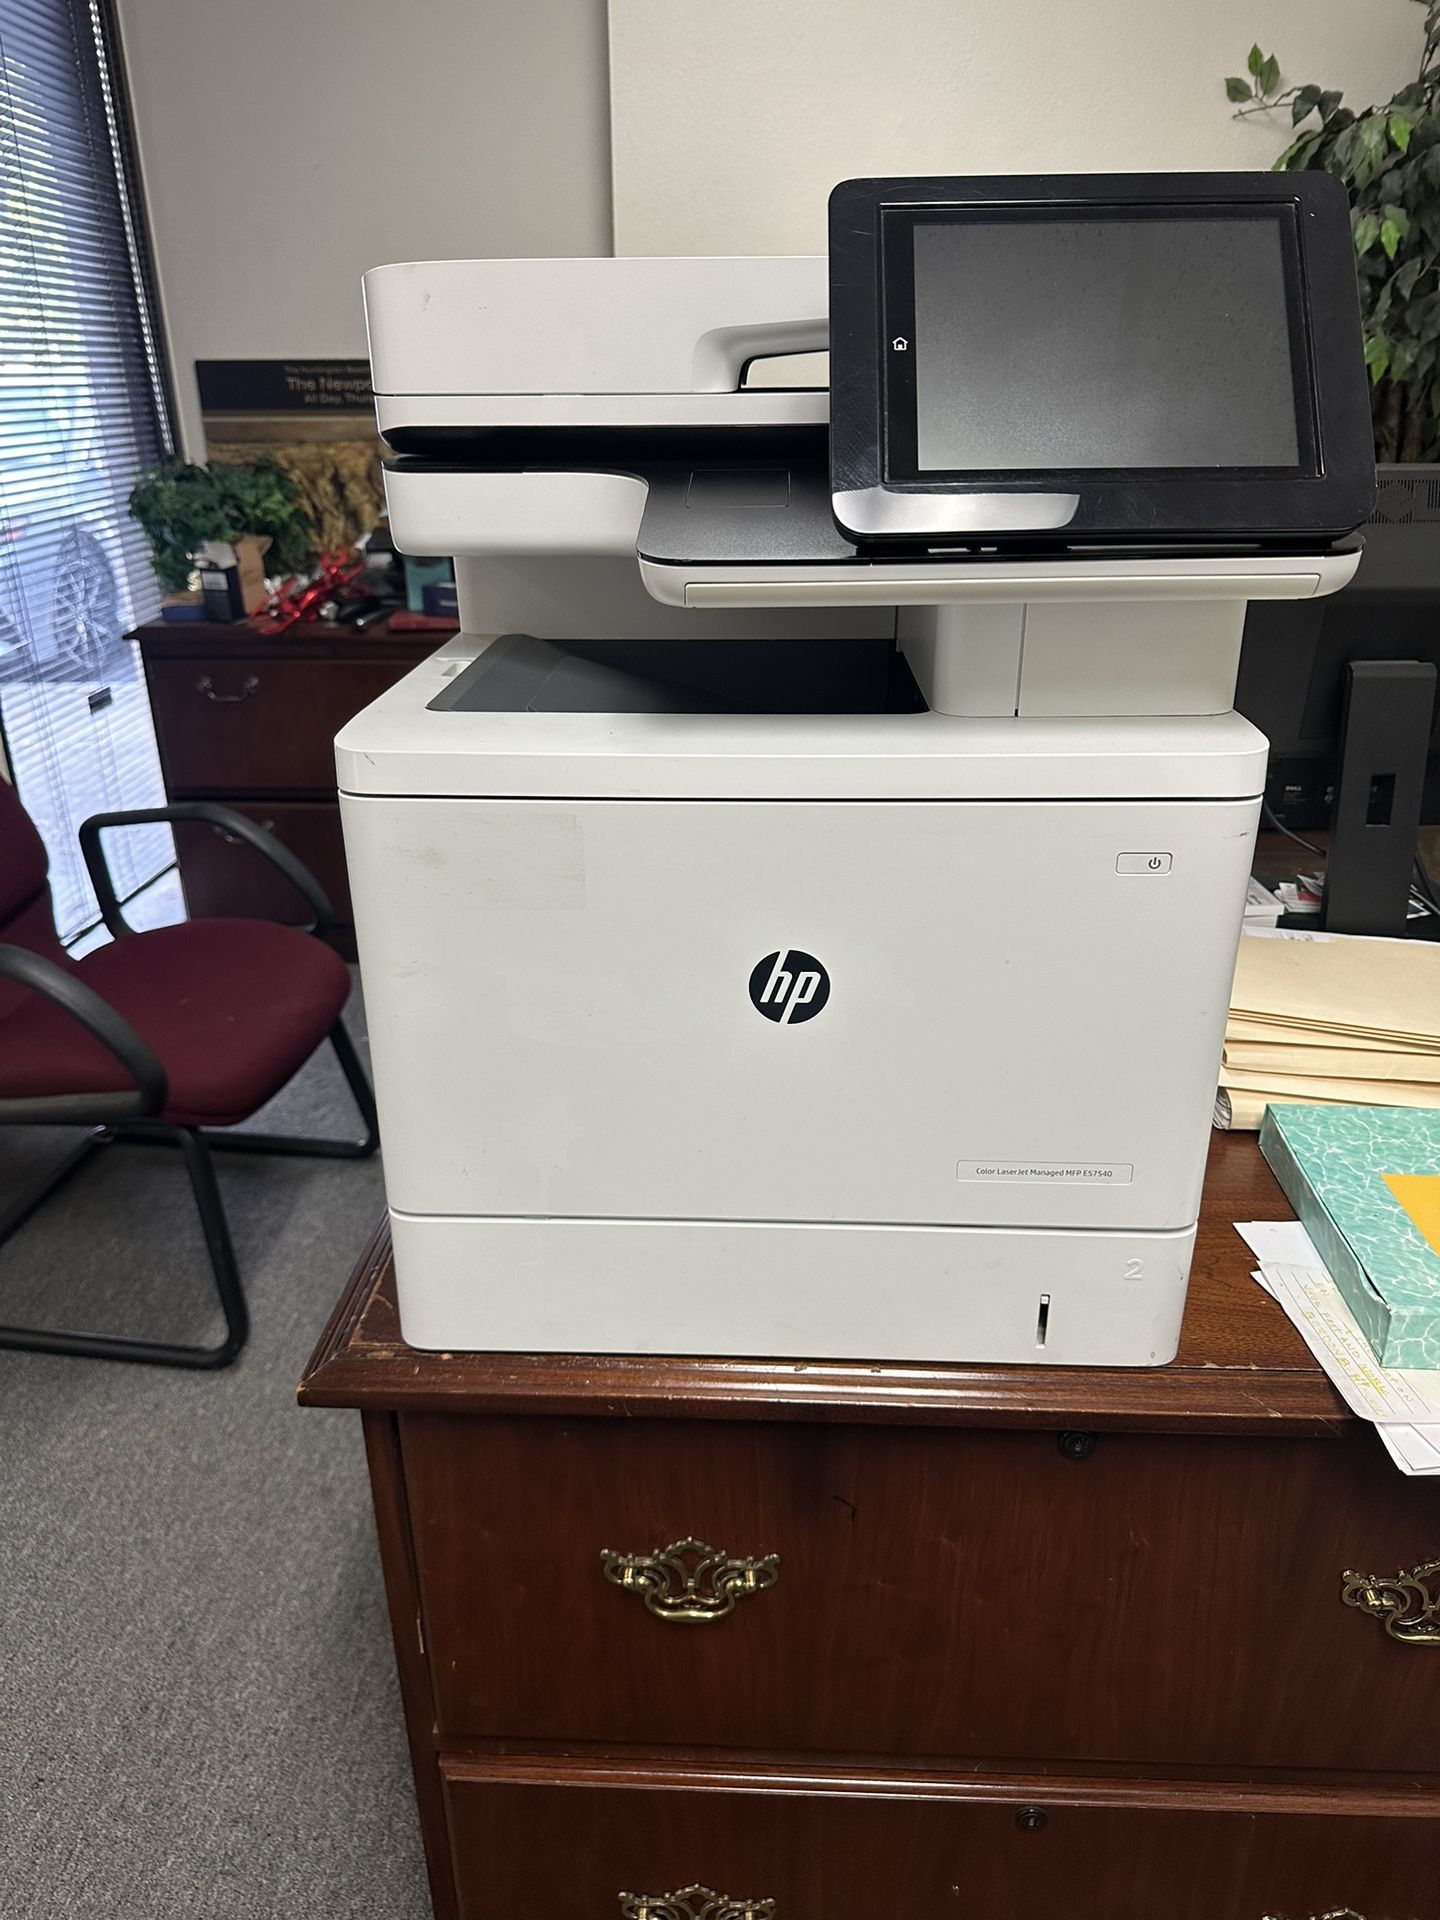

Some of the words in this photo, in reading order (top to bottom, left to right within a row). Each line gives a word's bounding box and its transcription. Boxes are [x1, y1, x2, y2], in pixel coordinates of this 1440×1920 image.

[286, 376, 316, 391] The
[760, 950, 821, 1024] hp
[976, 1167, 996, 1175] Color
[997, 1168, 1028, 1176] LaserJet
[1030, 1169, 1064, 1178] Managed
[1124, 1258, 1144, 1280] 2
